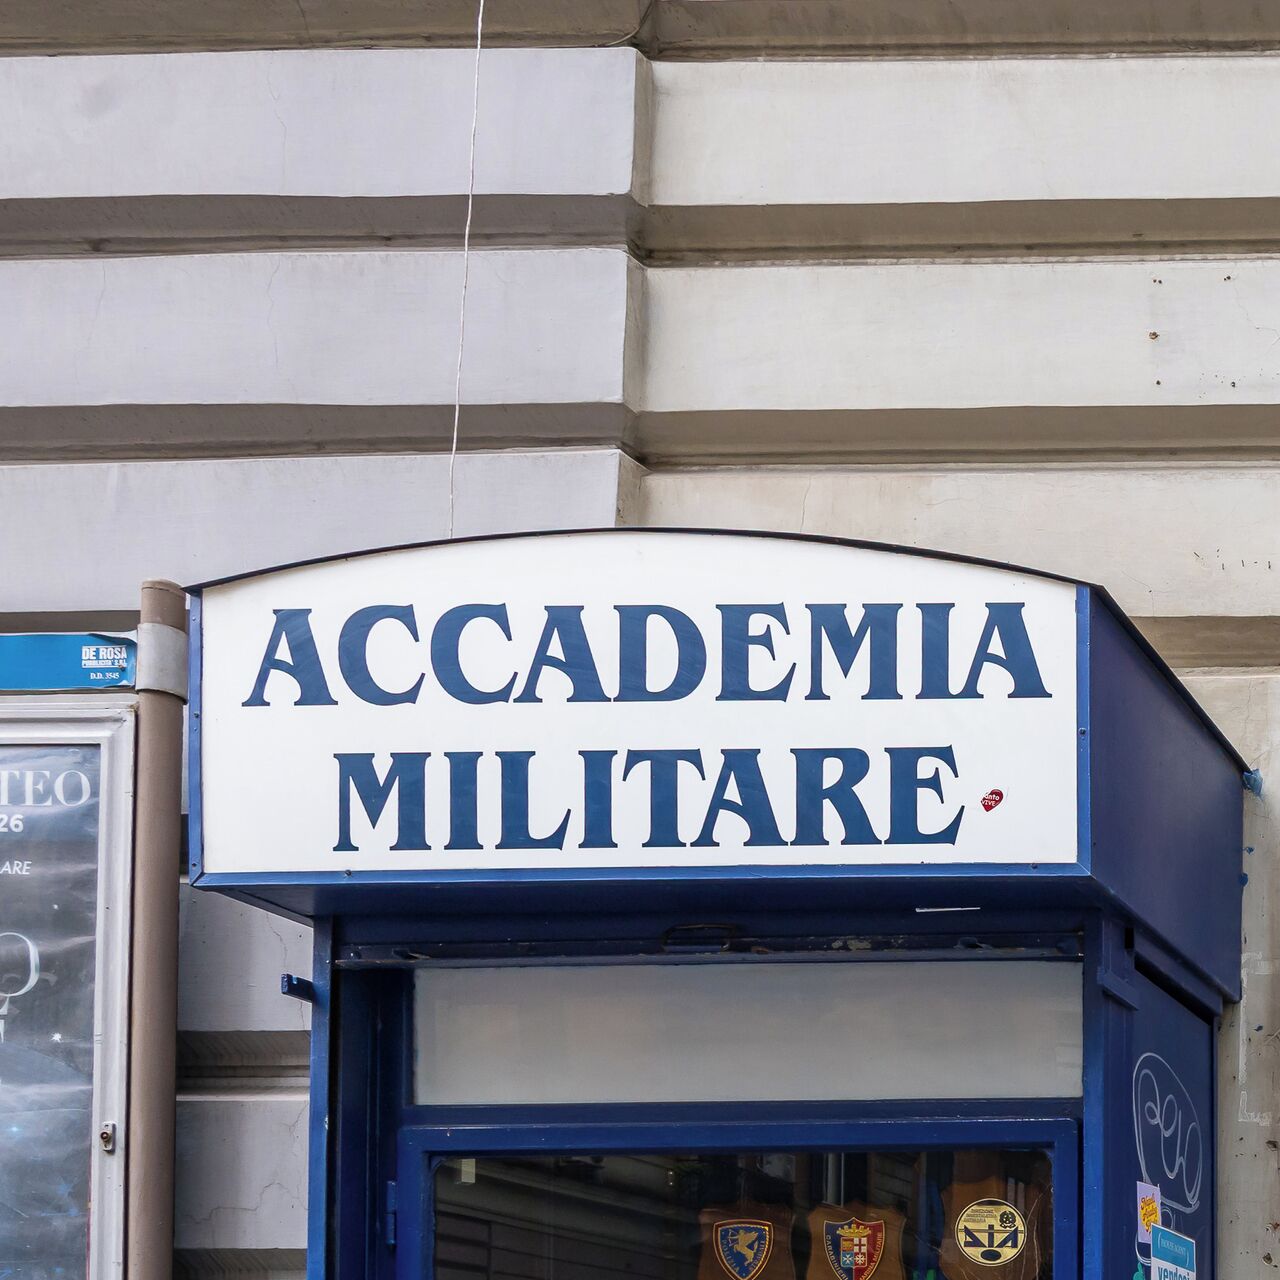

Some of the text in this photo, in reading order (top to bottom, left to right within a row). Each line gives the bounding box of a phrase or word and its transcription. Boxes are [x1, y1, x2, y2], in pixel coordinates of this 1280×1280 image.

[82, 647, 128, 660] DE ROSA
[105, 672, 119, 680] 3545
[242, 603, 1052, 707] ACCADEMIA
[332, 744, 966, 852] MILITARE
